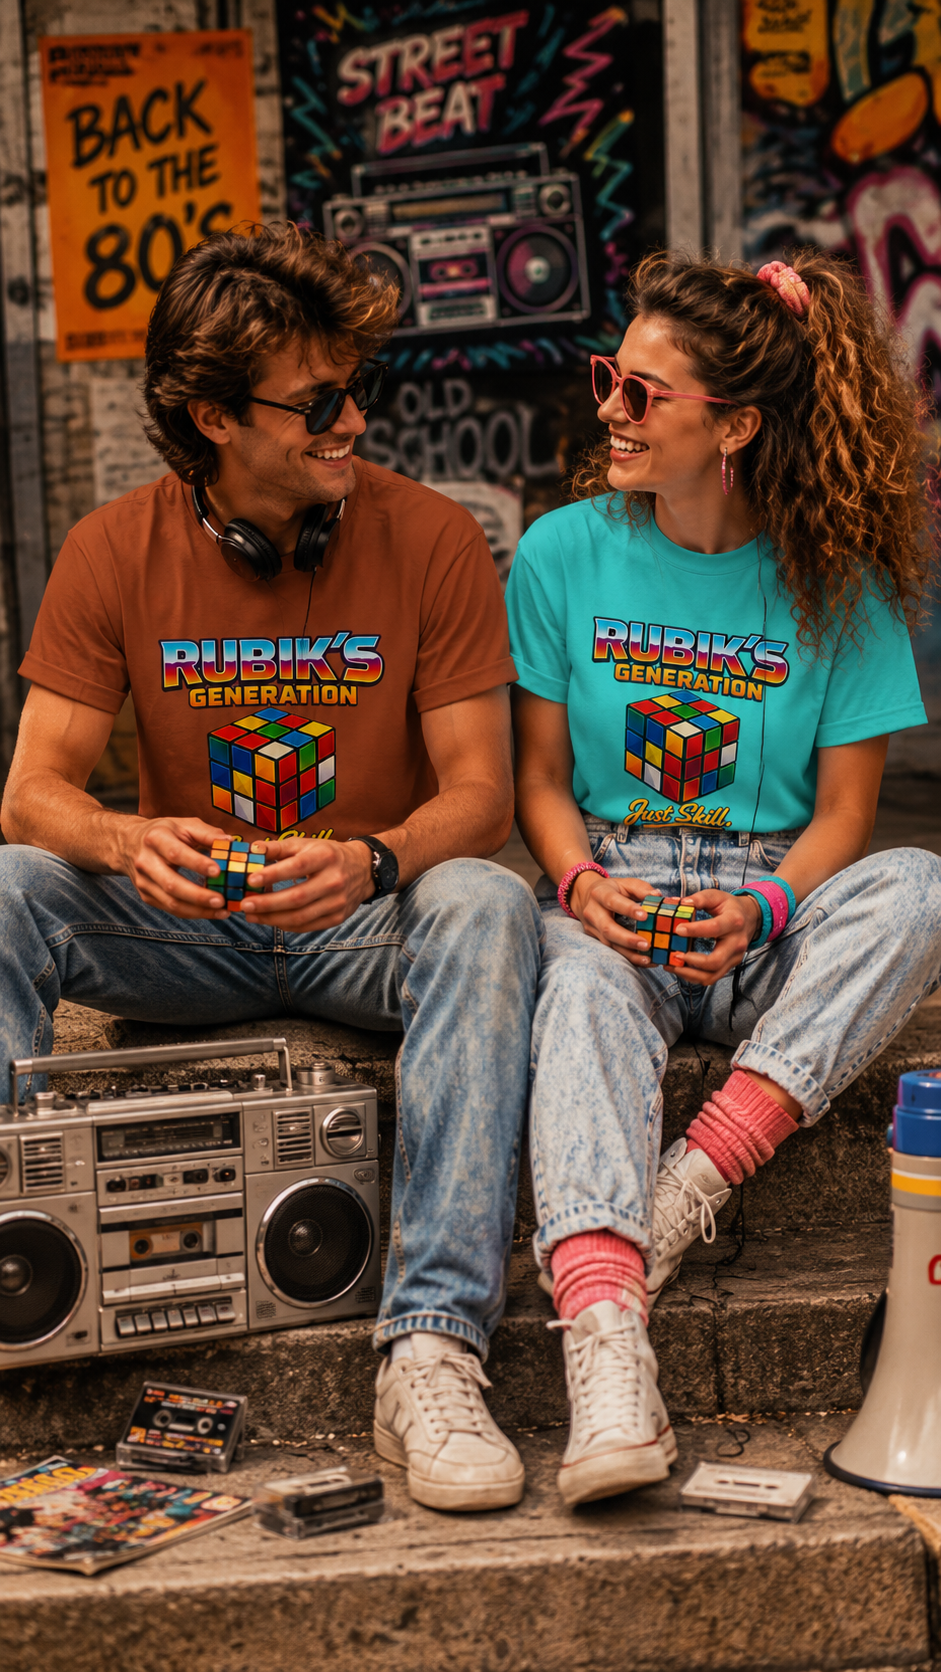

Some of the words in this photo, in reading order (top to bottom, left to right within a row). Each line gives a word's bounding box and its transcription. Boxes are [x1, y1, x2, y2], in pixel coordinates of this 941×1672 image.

[337, 10, 529, 106] STREET
[66, 79, 213, 169] BACK
[375, 73, 506, 154] BEAT
[88, 168, 138, 215] TO
[147, 143, 221, 199] THE
[400, 378, 472, 423] OLD
[364, 402, 562, 480] SCHOOL
[159, 631, 384, 691] RUBIK'S
[593, 617, 789, 687] RUBIK'S
[614, 662, 764, 702] GENERATION
[189, 684, 358, 708] GENERATION
[623, 798, 674, 826] Just
[675, 803, 732, 828] Skill.
